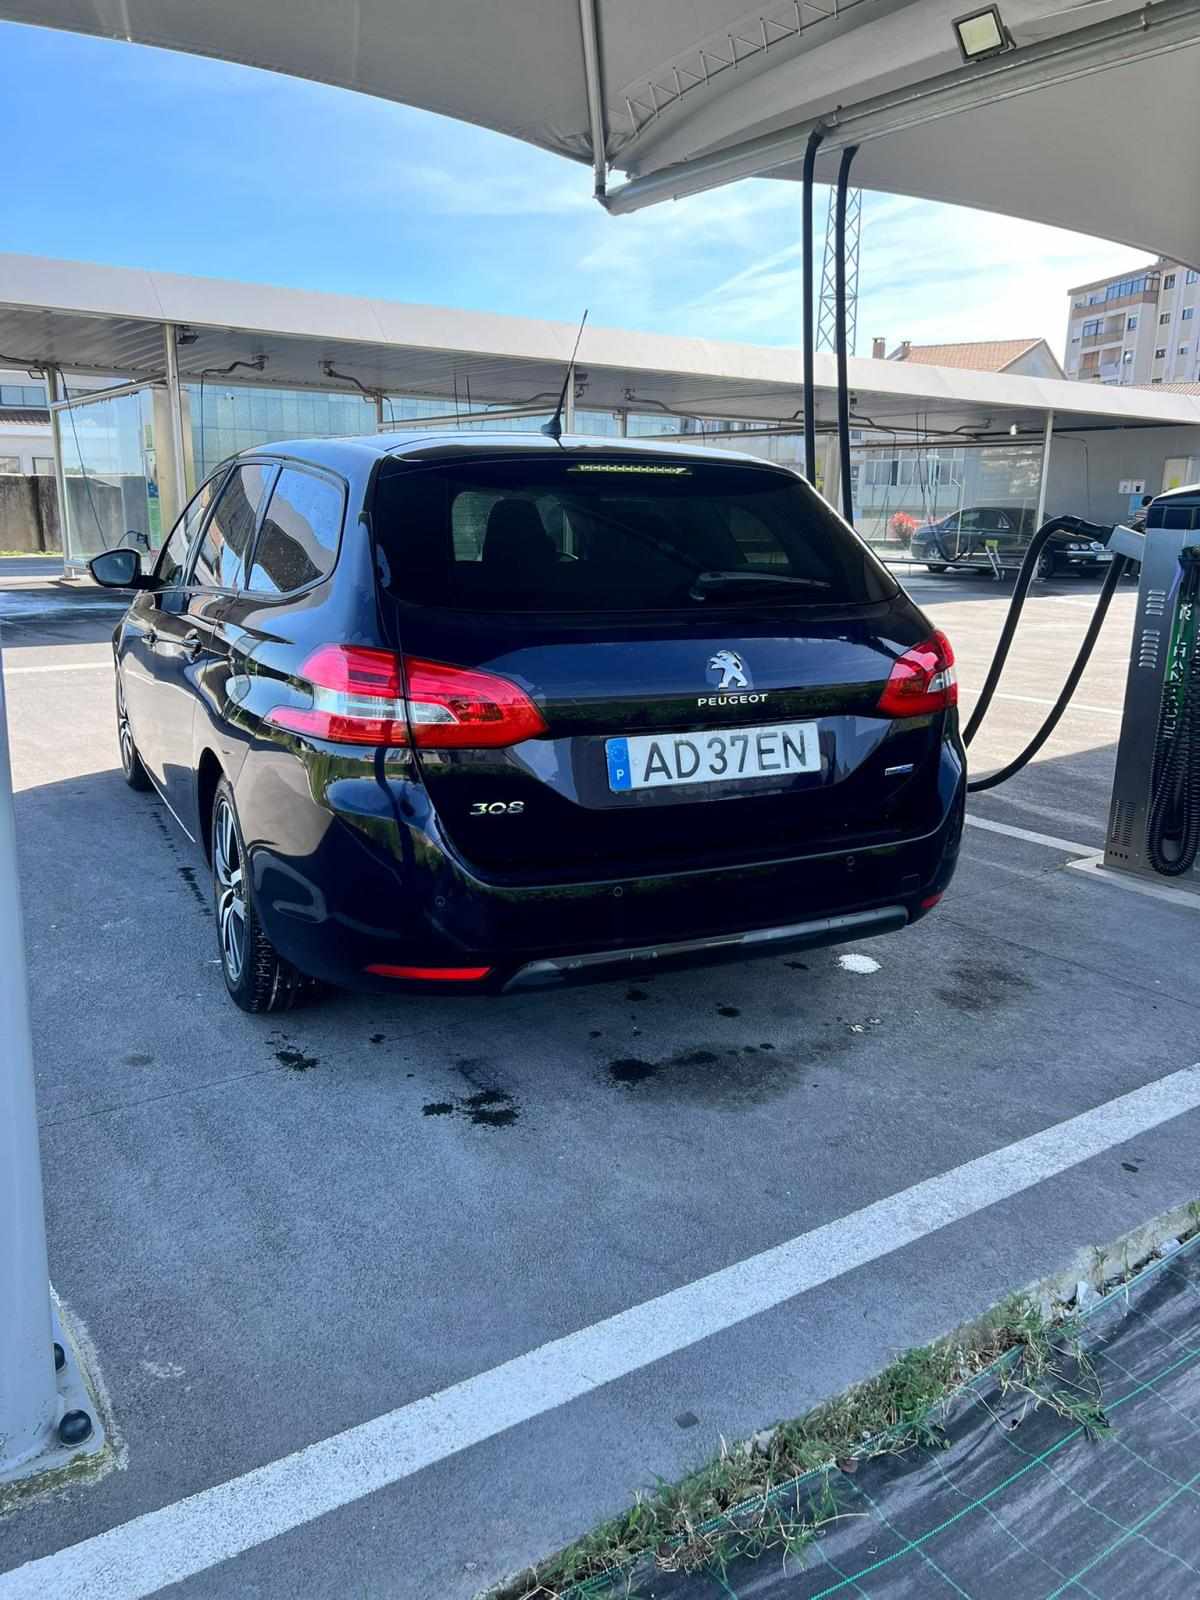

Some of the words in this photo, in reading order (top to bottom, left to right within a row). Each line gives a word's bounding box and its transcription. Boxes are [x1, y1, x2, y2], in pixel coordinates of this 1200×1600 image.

[697, 693, 769, 707] PEUGEOT
[616, 768, 625, 780] P
[469, 801, 525, 815] 308
